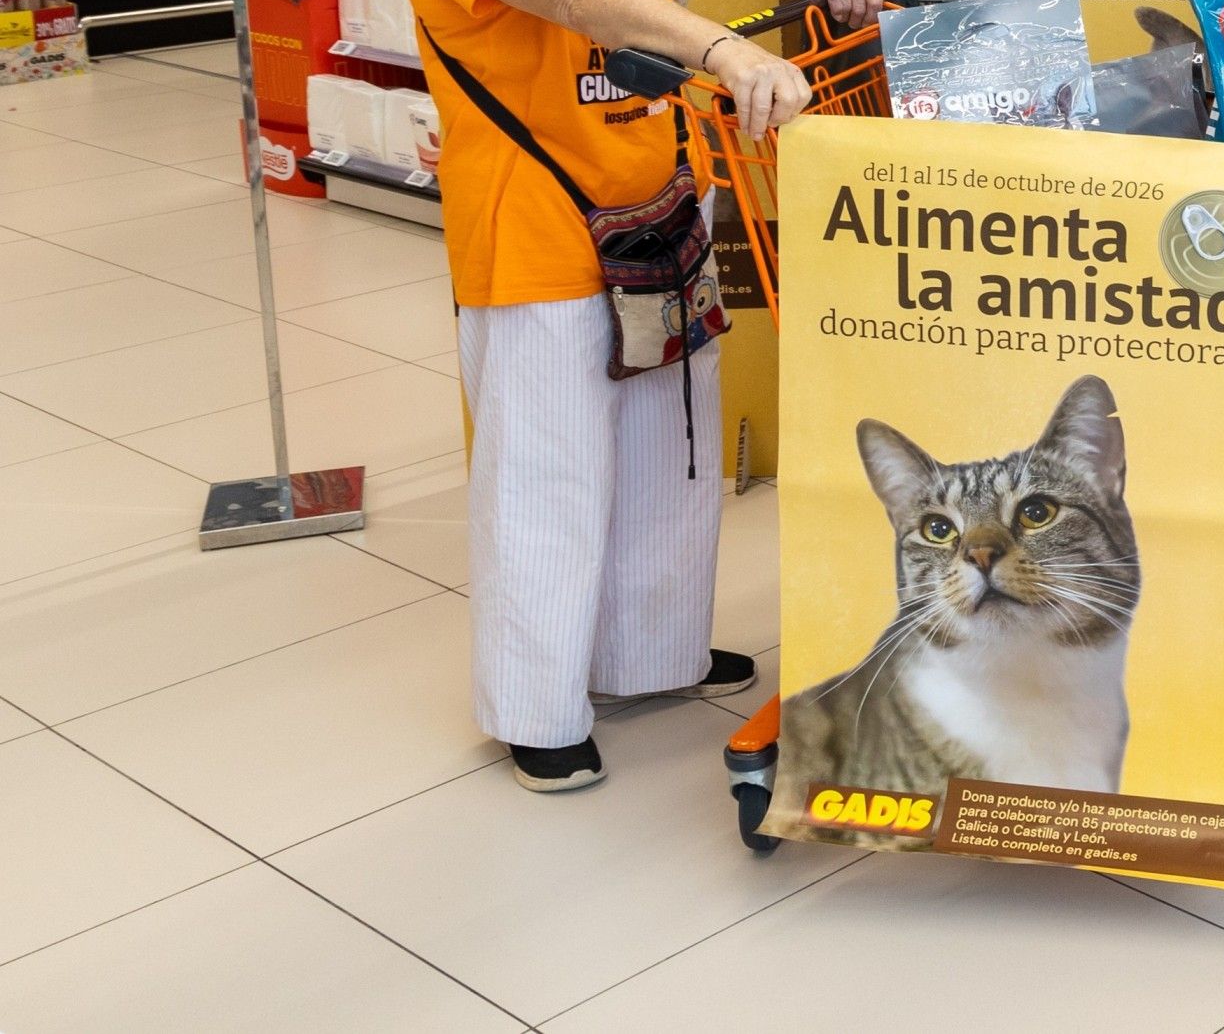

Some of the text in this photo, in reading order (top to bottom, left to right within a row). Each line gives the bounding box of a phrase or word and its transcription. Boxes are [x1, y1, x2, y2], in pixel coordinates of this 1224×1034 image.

[30, 53, 65, 64] GADIS
[913, 88, 1031, 115] ifa amigo
[863, 163, 1164, 200] del 1 al 15 de octubre de 2026
[823, 186, 1127, 263] Alimenta
[898, 252, 952, 312] la
[820, 309, 966, 346] donación
[975, 323, 1047, 355] para
[810, 790, 933, 830] GADIS
[959, 807, 1197, 840] para colaborar con 85 protectoras de
[961, 790, 994, 804] Dona
[997, 795, 1056, 811] producto
[1059, 799, 1079, 813] y/o
[1082, 800, 1103, 814] haz
[1108, 804, 1180, 823] aportación
[1180, 813, 1196, 824] en
[952, 833, 1137, 862] Listado completo en gadis.es
[955, 820, 1108, 845] Galicia o Castilla y León.
